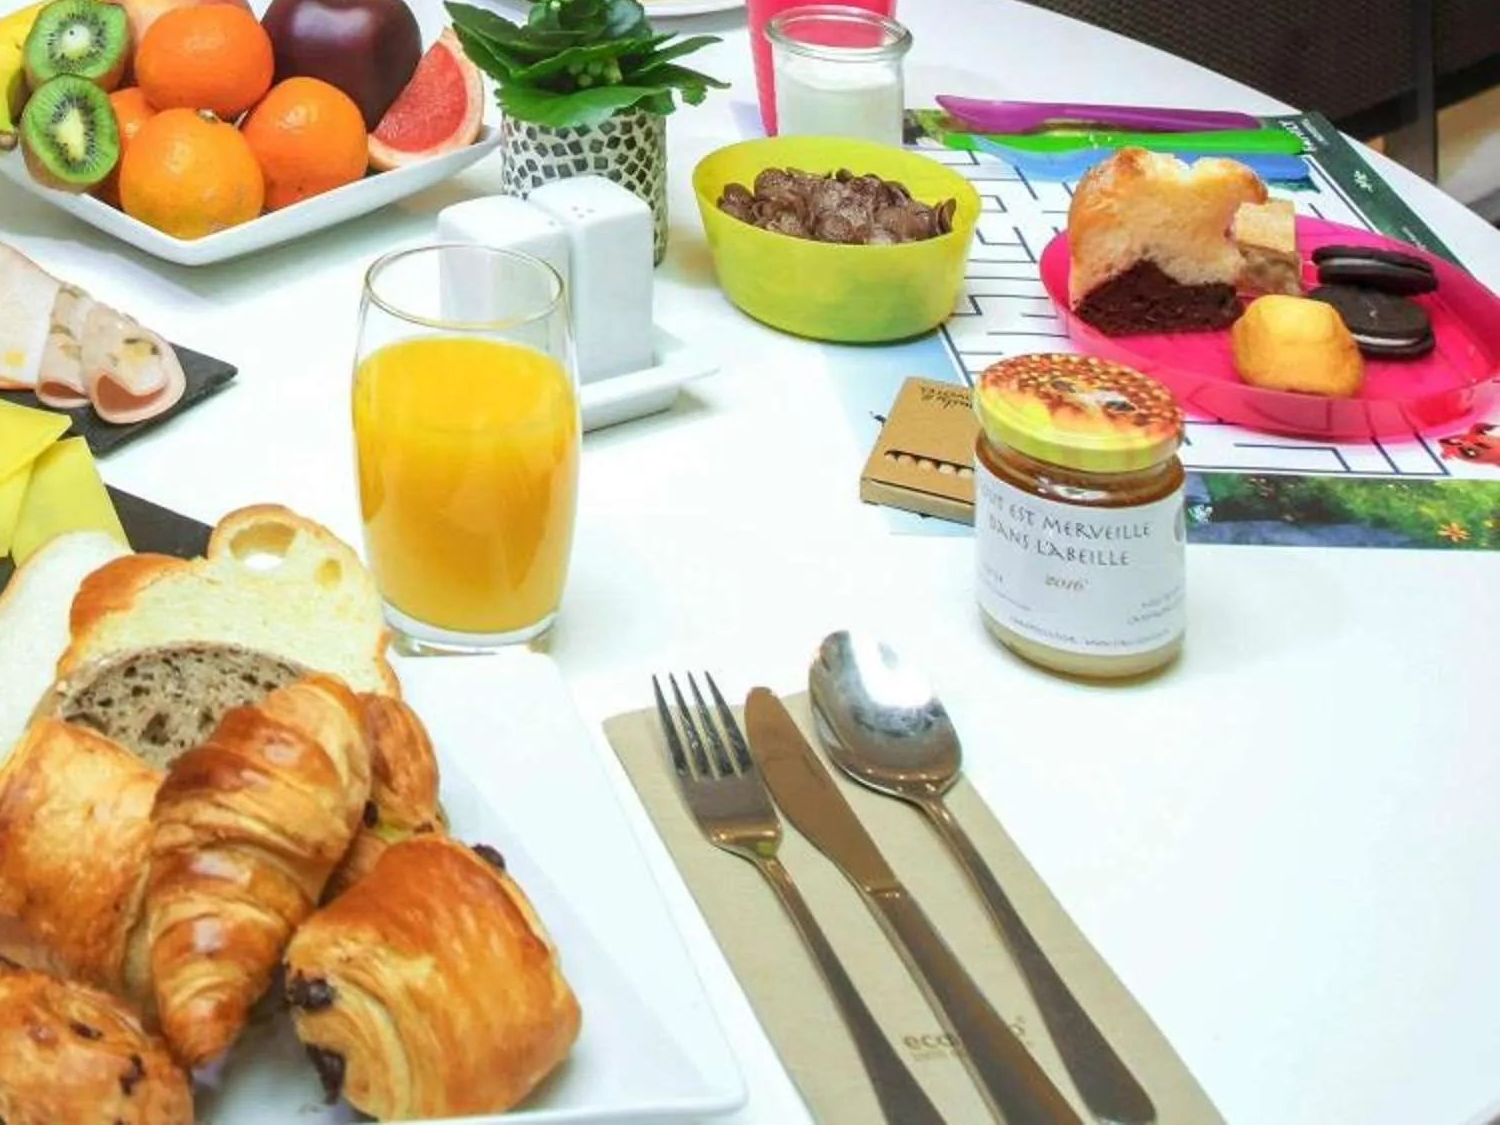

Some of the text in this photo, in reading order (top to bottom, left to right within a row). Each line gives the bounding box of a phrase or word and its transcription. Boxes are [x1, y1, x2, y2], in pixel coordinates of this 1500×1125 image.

[1009, 503, 1035, 526] EST
[1042, 515, 1152, 540] MERVEILLE
[1036, 539, 1131, 566] L'ABEILLE
